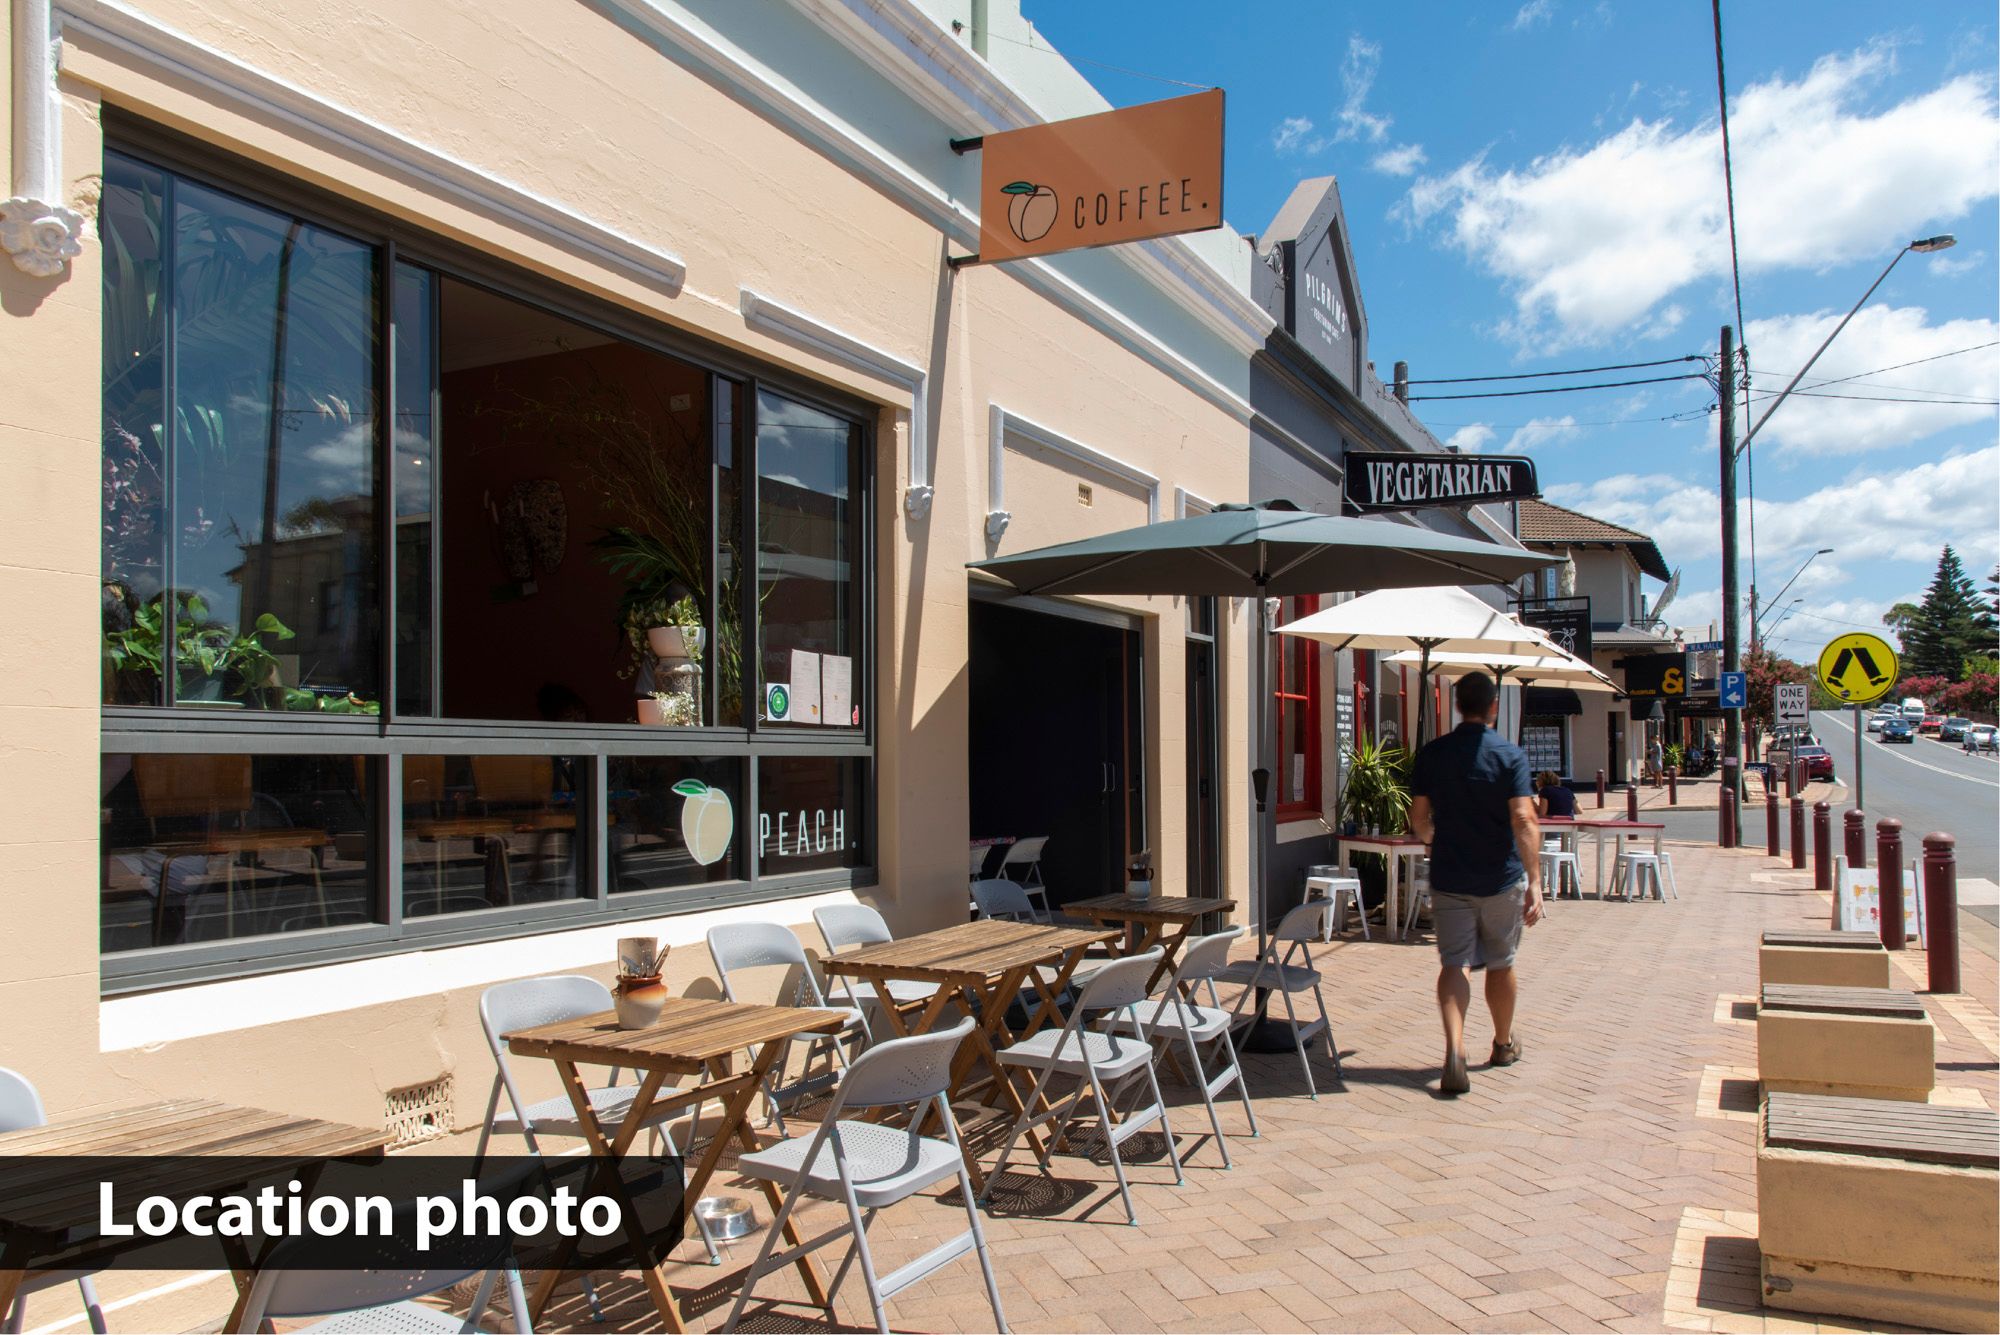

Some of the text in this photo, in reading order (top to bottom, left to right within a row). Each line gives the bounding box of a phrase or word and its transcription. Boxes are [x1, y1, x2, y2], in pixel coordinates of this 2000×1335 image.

[1074, 178, 1208, 230] COFFEE.
[1366, 461, 1512, 504] VEGETARIAN
[1727, 676, 1739, 689] P
[1780, 687, 1804, 698] ONE
[1779, 700, 1805, 710] WAY
